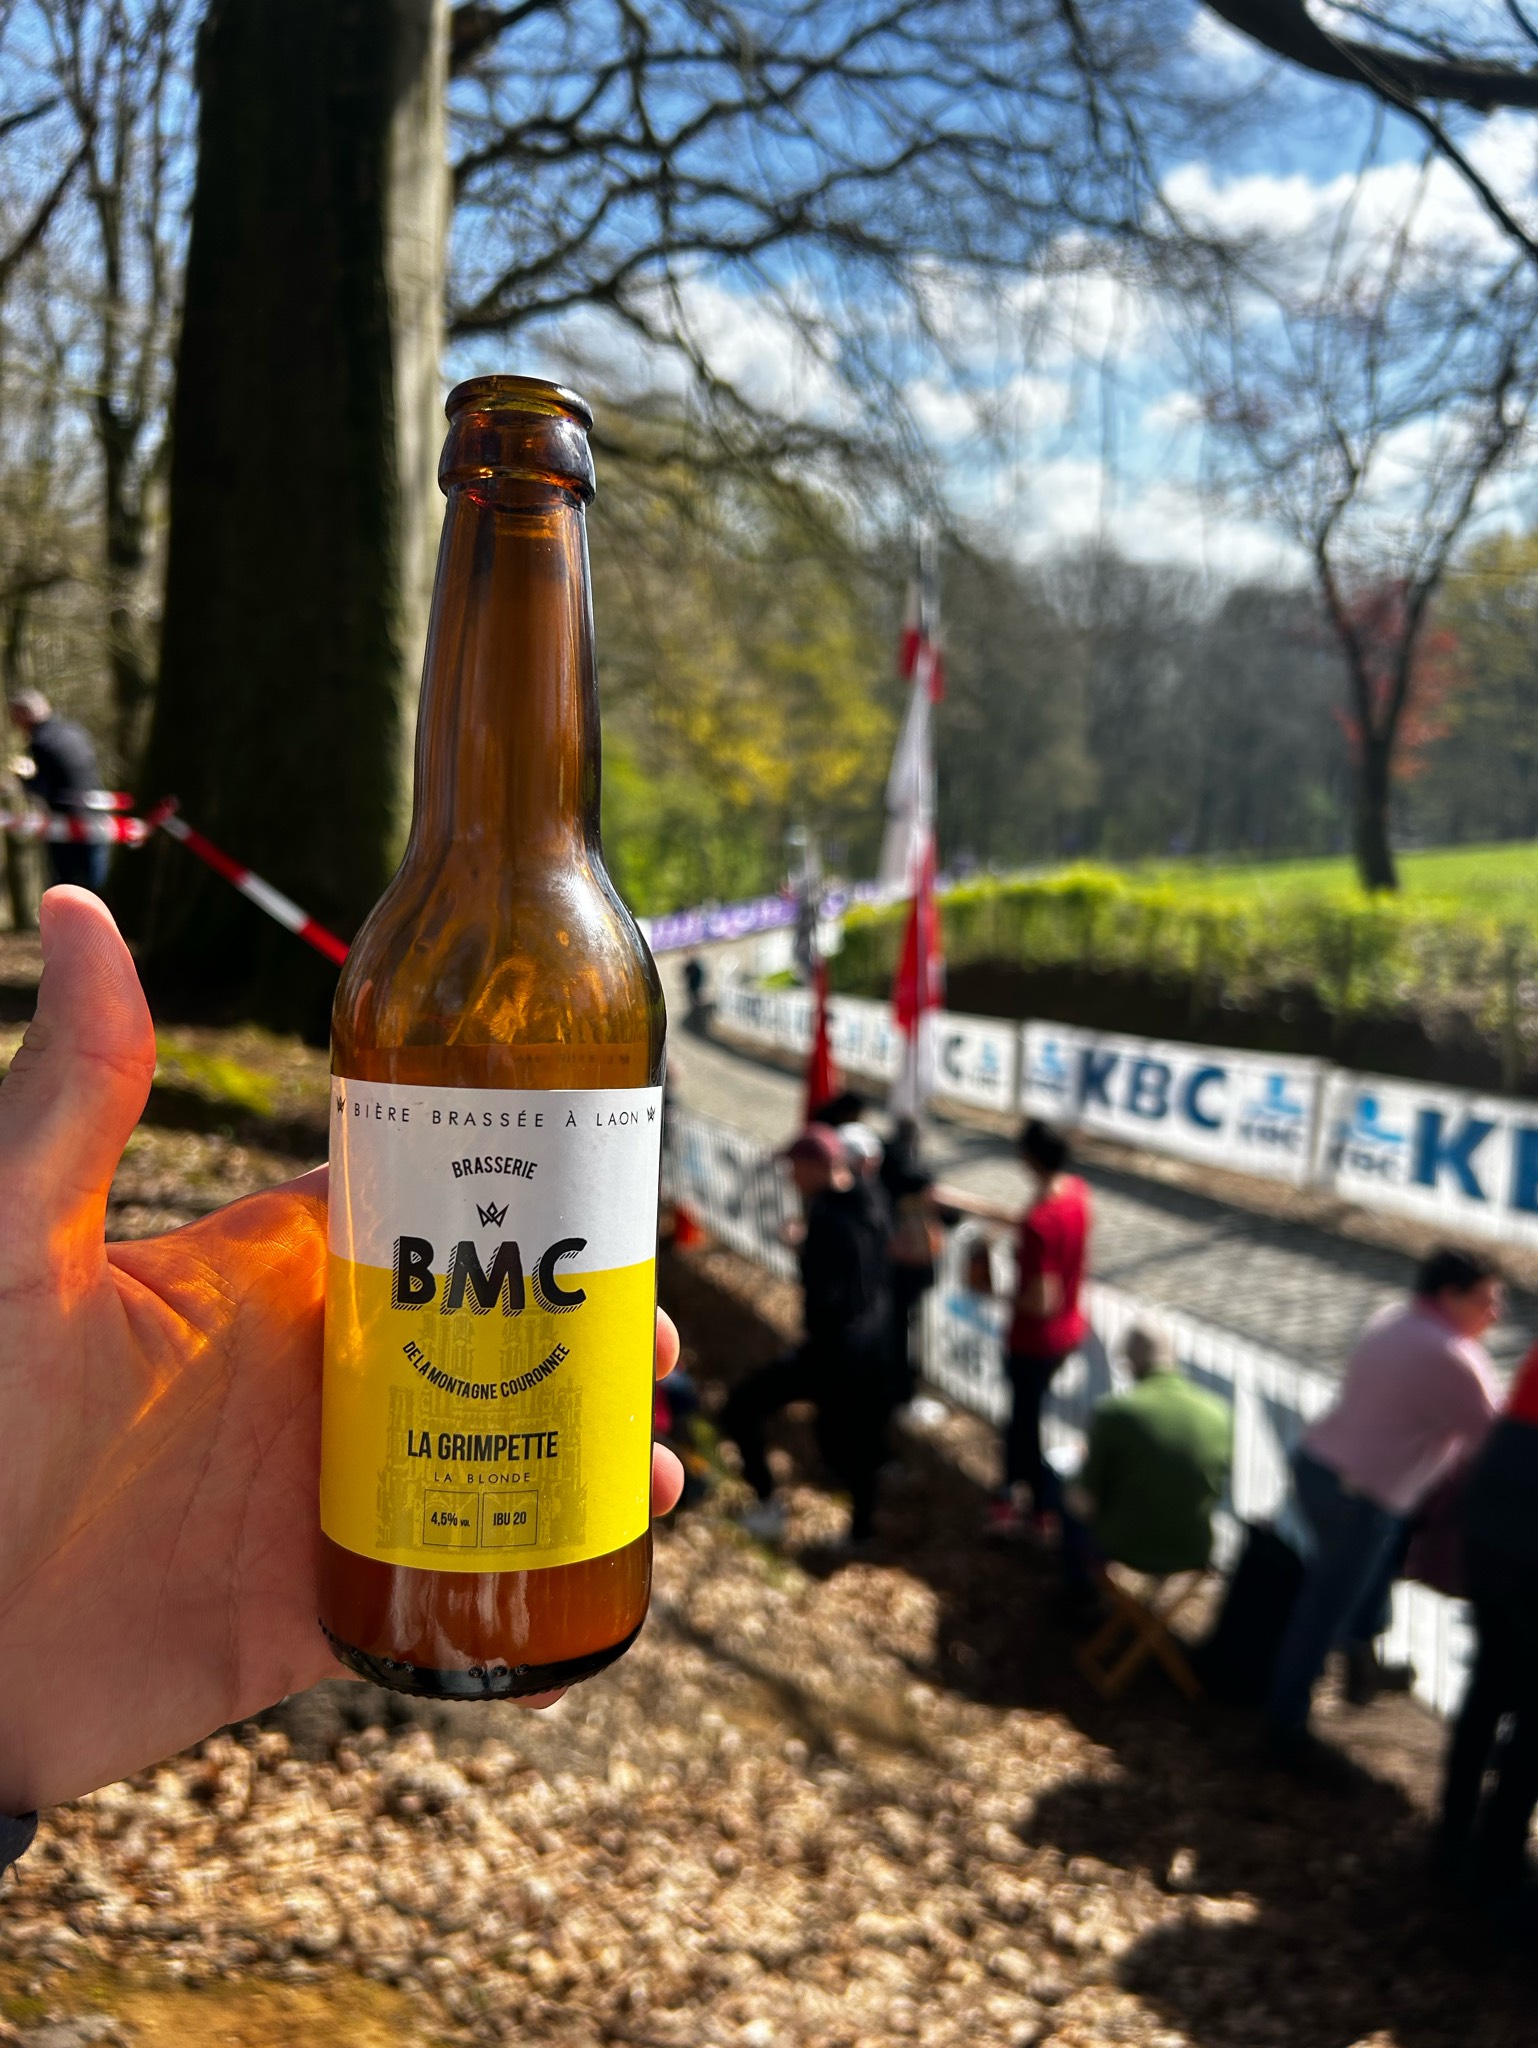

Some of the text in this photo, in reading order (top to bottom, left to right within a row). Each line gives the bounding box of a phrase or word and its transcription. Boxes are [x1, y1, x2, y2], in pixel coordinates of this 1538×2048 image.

[1080, 1047, 1226, 1130] KBC
[354, 1102, 638, 1127] BIÈRE BRASSÉE À LAON
[451, 1155, 538, 1180] BRASSERIE
[391, 1235, 588, 1317] BMC
[407, 1429, 559, 1462] LA GRIMPETTE
[434, 1471, 531, 1484] LA BLONDE
[430, 1511, 458, 1527] 4,5%
[493, 1511, 527, 1526] IBU 20
